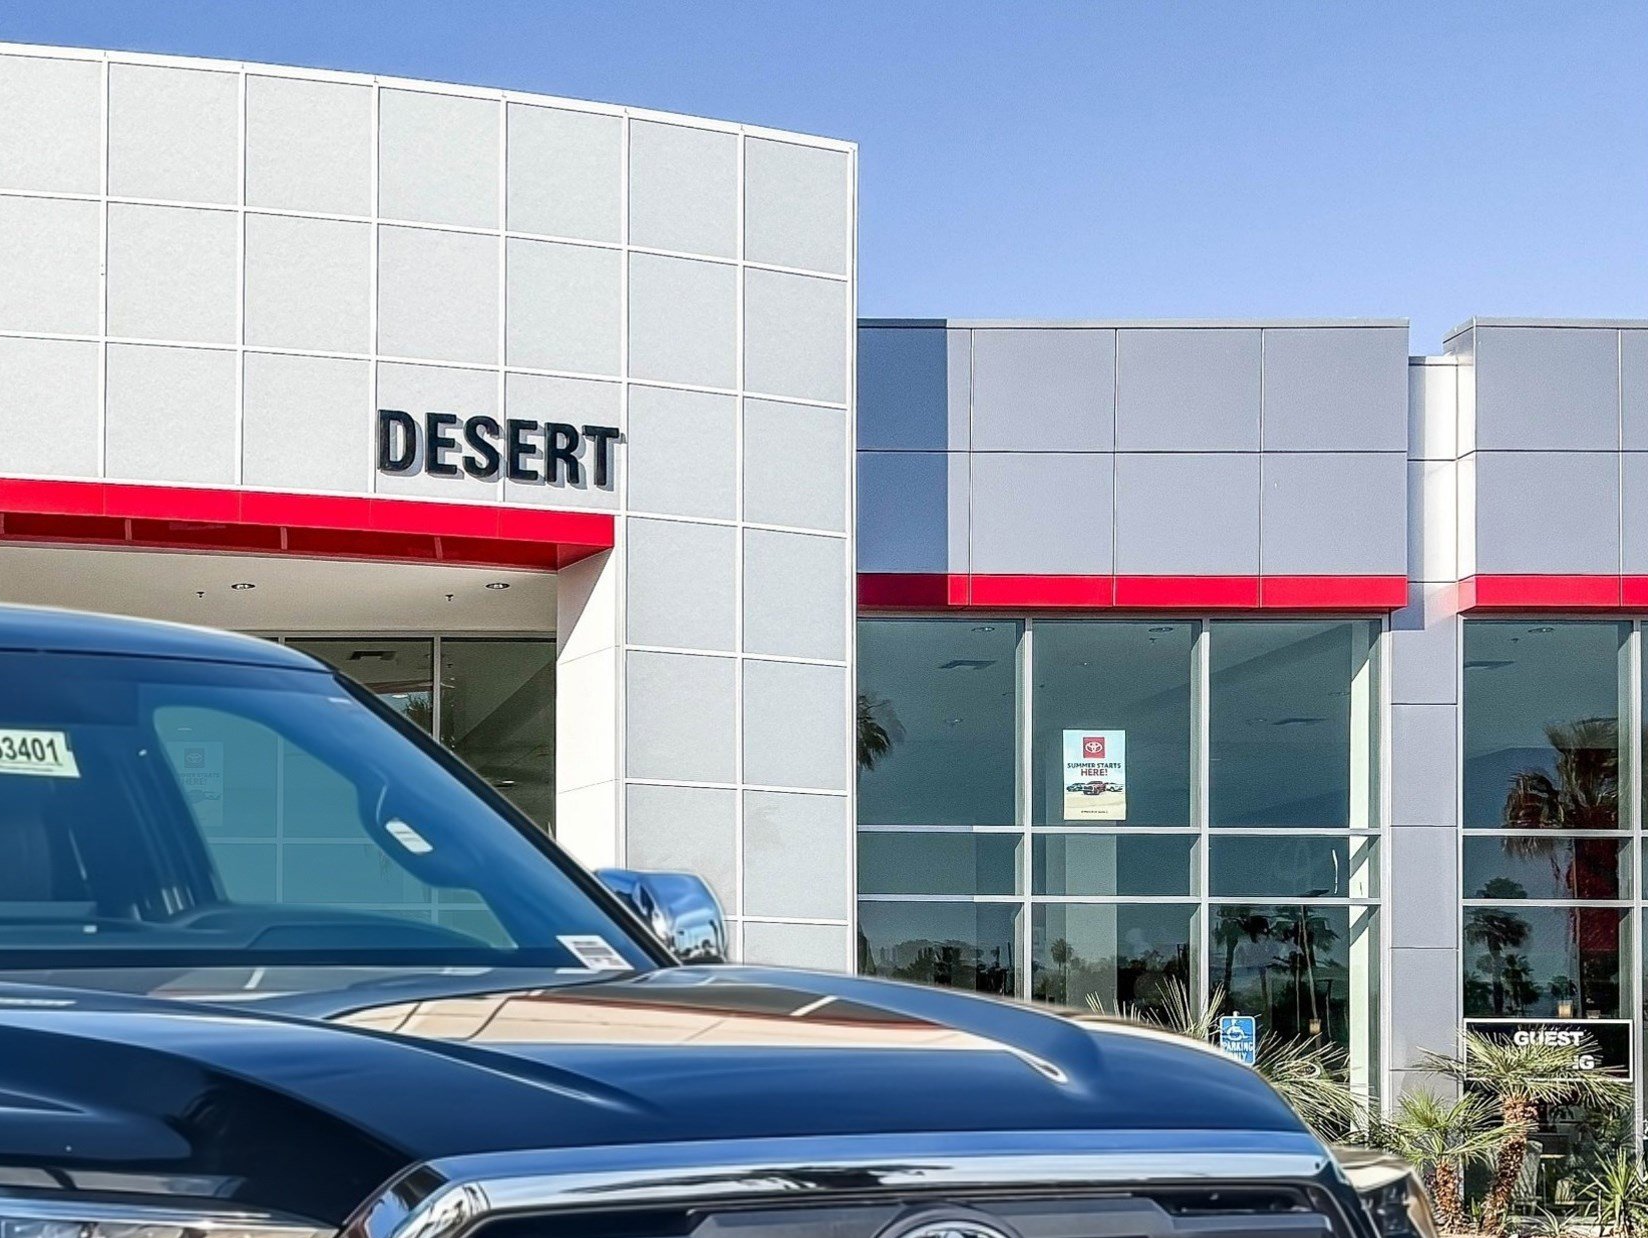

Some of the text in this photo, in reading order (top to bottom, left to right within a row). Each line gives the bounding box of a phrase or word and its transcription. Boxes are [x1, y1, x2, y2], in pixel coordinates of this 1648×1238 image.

[377, 409, 620, 486] DESERT
[1080, 768, 1108, 777] HERE!
[1513, 1030, 1584, 1047] GUEST
[1223, 1041, 1253, 1051] PARKING
